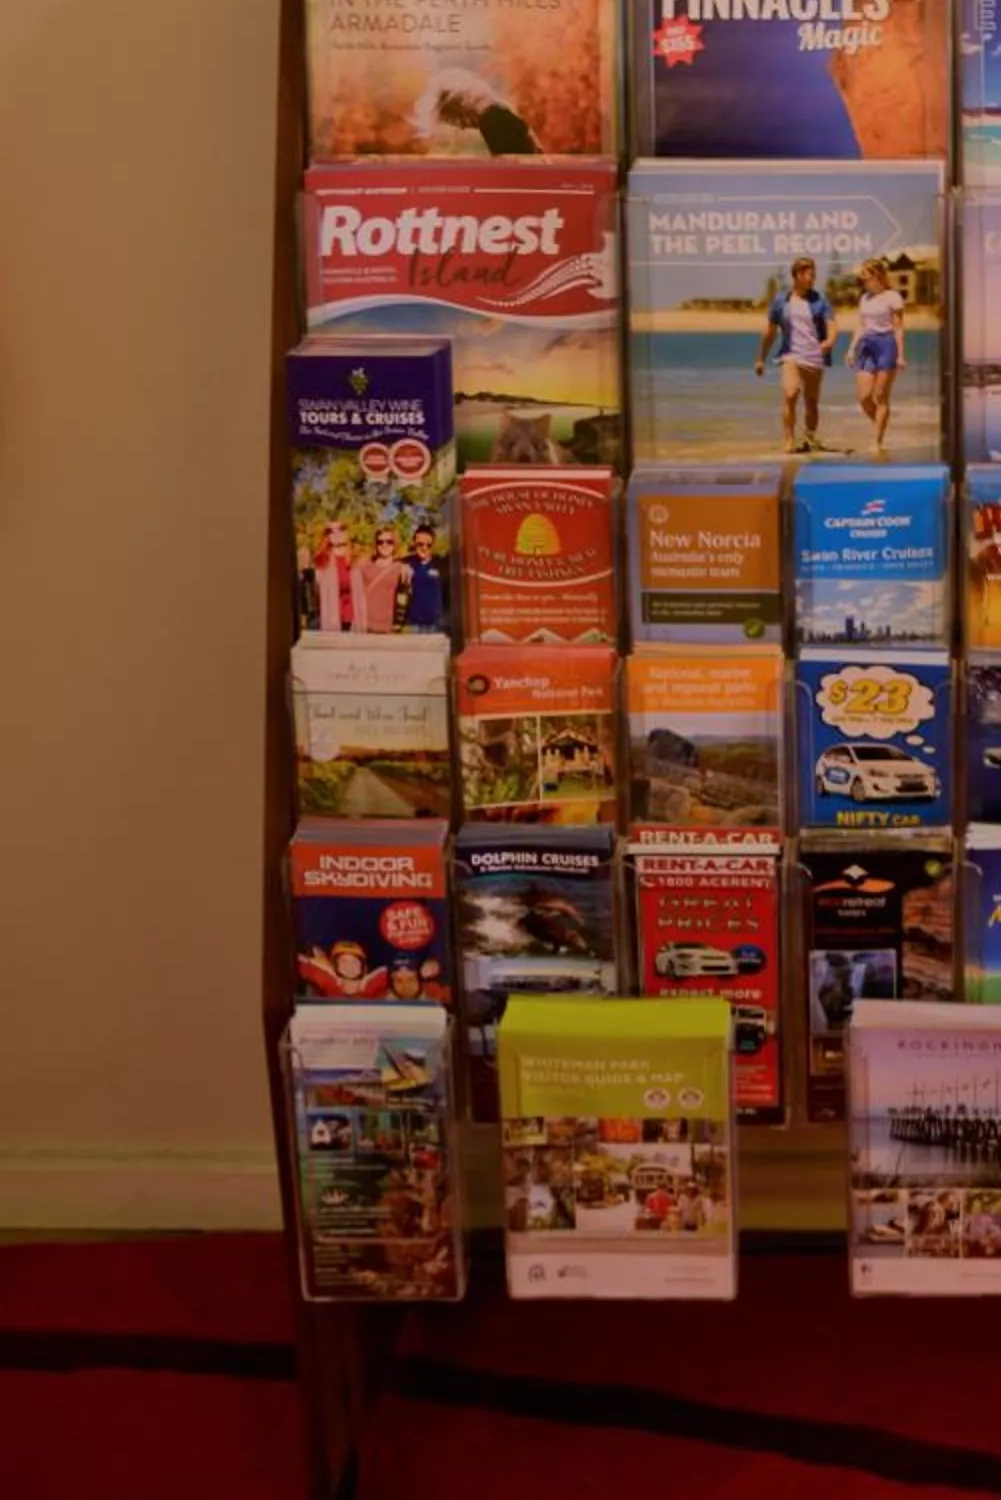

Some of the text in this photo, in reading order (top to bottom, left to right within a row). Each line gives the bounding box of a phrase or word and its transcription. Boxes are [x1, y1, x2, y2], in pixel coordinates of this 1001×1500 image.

[330, 13, 461, 33] ARMADALE
[797, 21, 884, 55] Magic
[649, 211, 858, 232] MANDURAH AND
[320, 205, 564, 256] Rottnest
[651, 233, 872, 255] THE PEEL REGION
[407, 244, 518, 288] Island
[300, 411, 347, 425] TOURS
[366, 411, 425, 425] CRUISES
[650, 529, 761, 549] New Norcia
[801, 547, 934, 562] Swan River Cruises
[836, 811, 892, 826] NIFTY
[639, 829, 774, 845] RENT-A-CAR
[319, 855, 415, 871] INDOOR
[471, 851, 599, 867] DOLPHIN CRUISES
[642, 859, 769, 871] RENT-A-CAR
[304, 870, 432, 889] SKYDIVING
[657, 876, 694, 888] 1800
